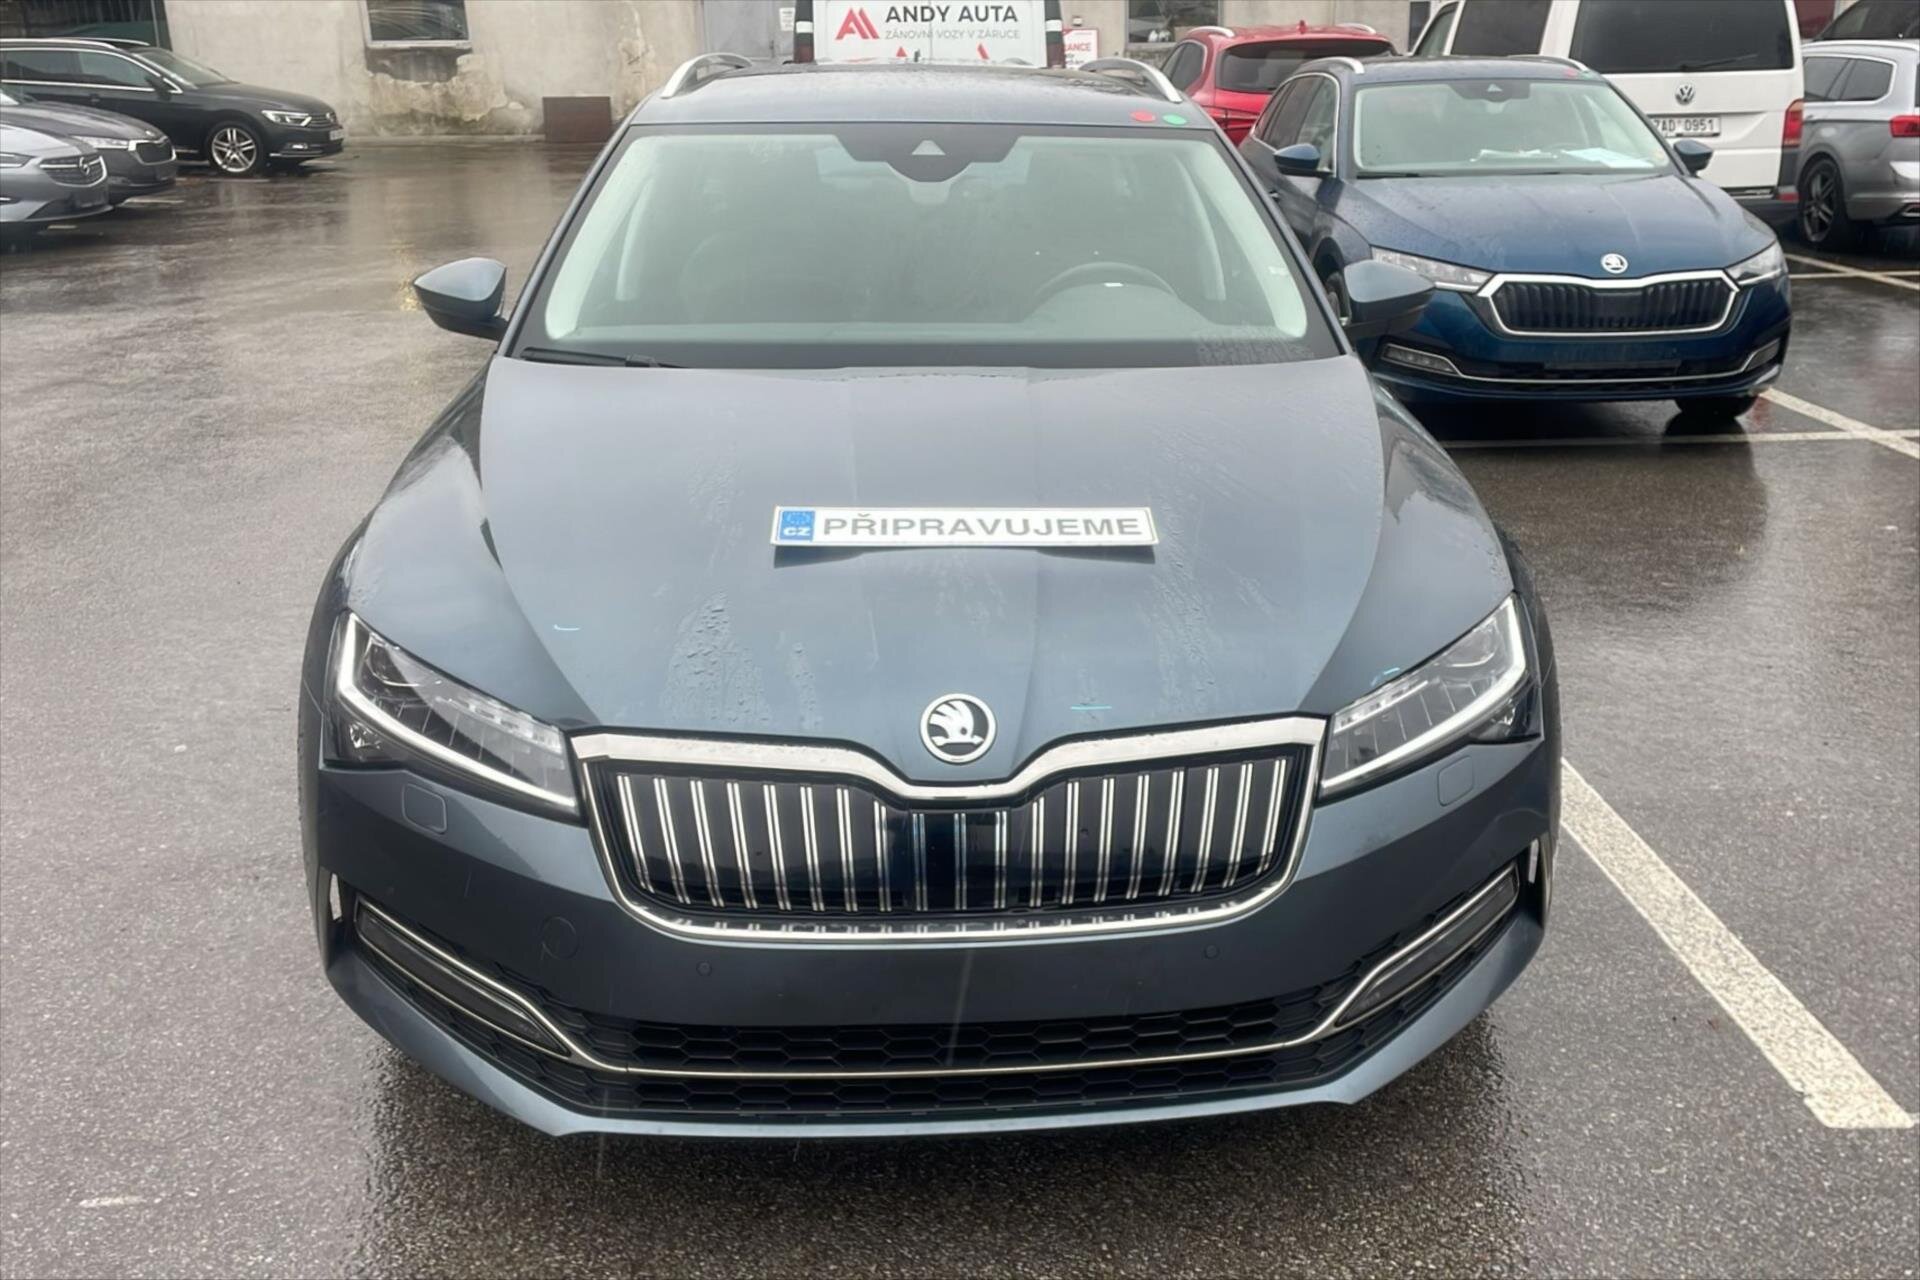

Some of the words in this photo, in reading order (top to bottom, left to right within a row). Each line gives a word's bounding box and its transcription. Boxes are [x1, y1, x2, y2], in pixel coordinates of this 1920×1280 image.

[885, 5, 950, 22] ANDY
[958, 5, 1018, 22] AUTA
[938, 29, 963, 39] VOZY
[967, 30, 976, 39] V
[1684, 119, 1713, 132] 0951
[783, 527, 810, 537] CZ
[824, 513, 1142, 536] PŘIPRAVUJEME
